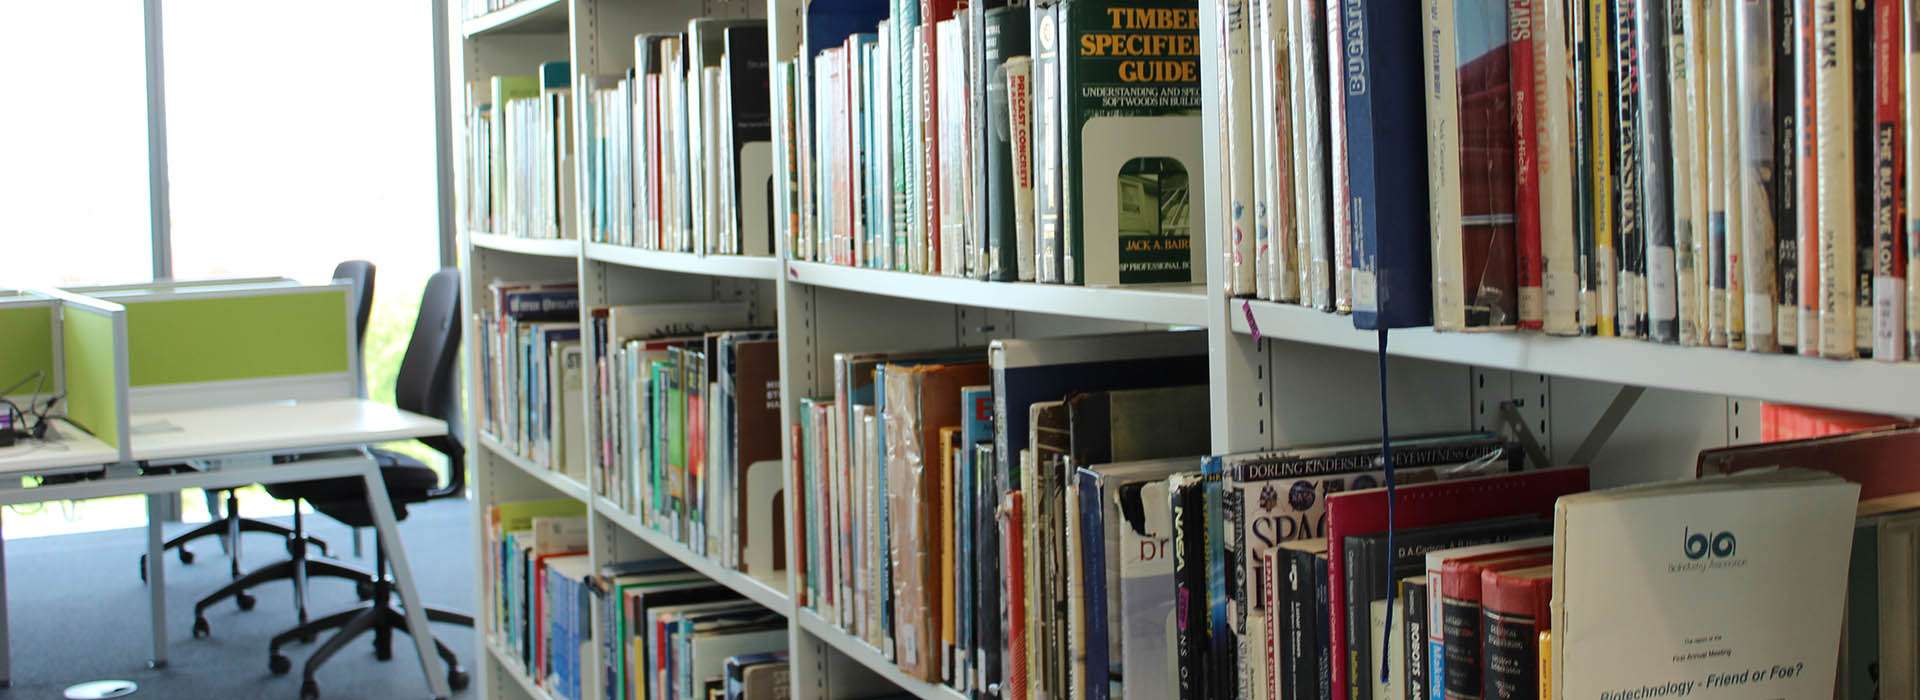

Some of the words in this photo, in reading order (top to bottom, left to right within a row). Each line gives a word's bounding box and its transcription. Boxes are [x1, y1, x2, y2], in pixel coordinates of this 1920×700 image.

[1508, 0, 1531, 42] CARS
[1782, 17, 1794, 56] Design
[1118, 60, 1196, 82] GUIDE
[1017, 74, 1027, 126] PRECAST
[1082, 86, 1158, 97] UNDERSTANDING
[1160, 86, 1180, 97] AND
[1102, 96, 1158, 106] SOFTWOODS
[1159, 96, 1168, 106] IN
[1515, 90, 1527, 137] Roger
[1019, 128, 1029, 188] CONCRETE
[1517, 139, 1529, 185] Hicks
[1879, 128, 1892, 162] THE
[924, 137, 935, 251] handboo
[1879, 167, 1893, 199] BUS
[1879, 204, 1893, 235] WE
[1125, 239, 1150, 251] JACK
[1249, 460, 1304, 479] DORLING
[1304, 454, 1376, 475] KINDERSLEY
[1395, 447, 1464, 465] EYEWITNESS
[1175, 505, 1186, 572] NASA
[1234, 490, 1246, 563] EYEWITNESS
[1265, 560, 1273, 596] SPACE
[1266, 600, 1274, 641] TRAVEL
[1410, 621, 1422, 677] ROBOTS
[1672, 655, 1686, 664] First
[1686, 651, 1708, 661] Annual
[1708, 648, 1733, 659] Meeting
[1600, 679, 1695, 700] Biotechnology
[1706, 667, 1748, 689] Friend
[1751, 668, 1768, 682] or
[1769, 662, 1804, 681] Foe?
